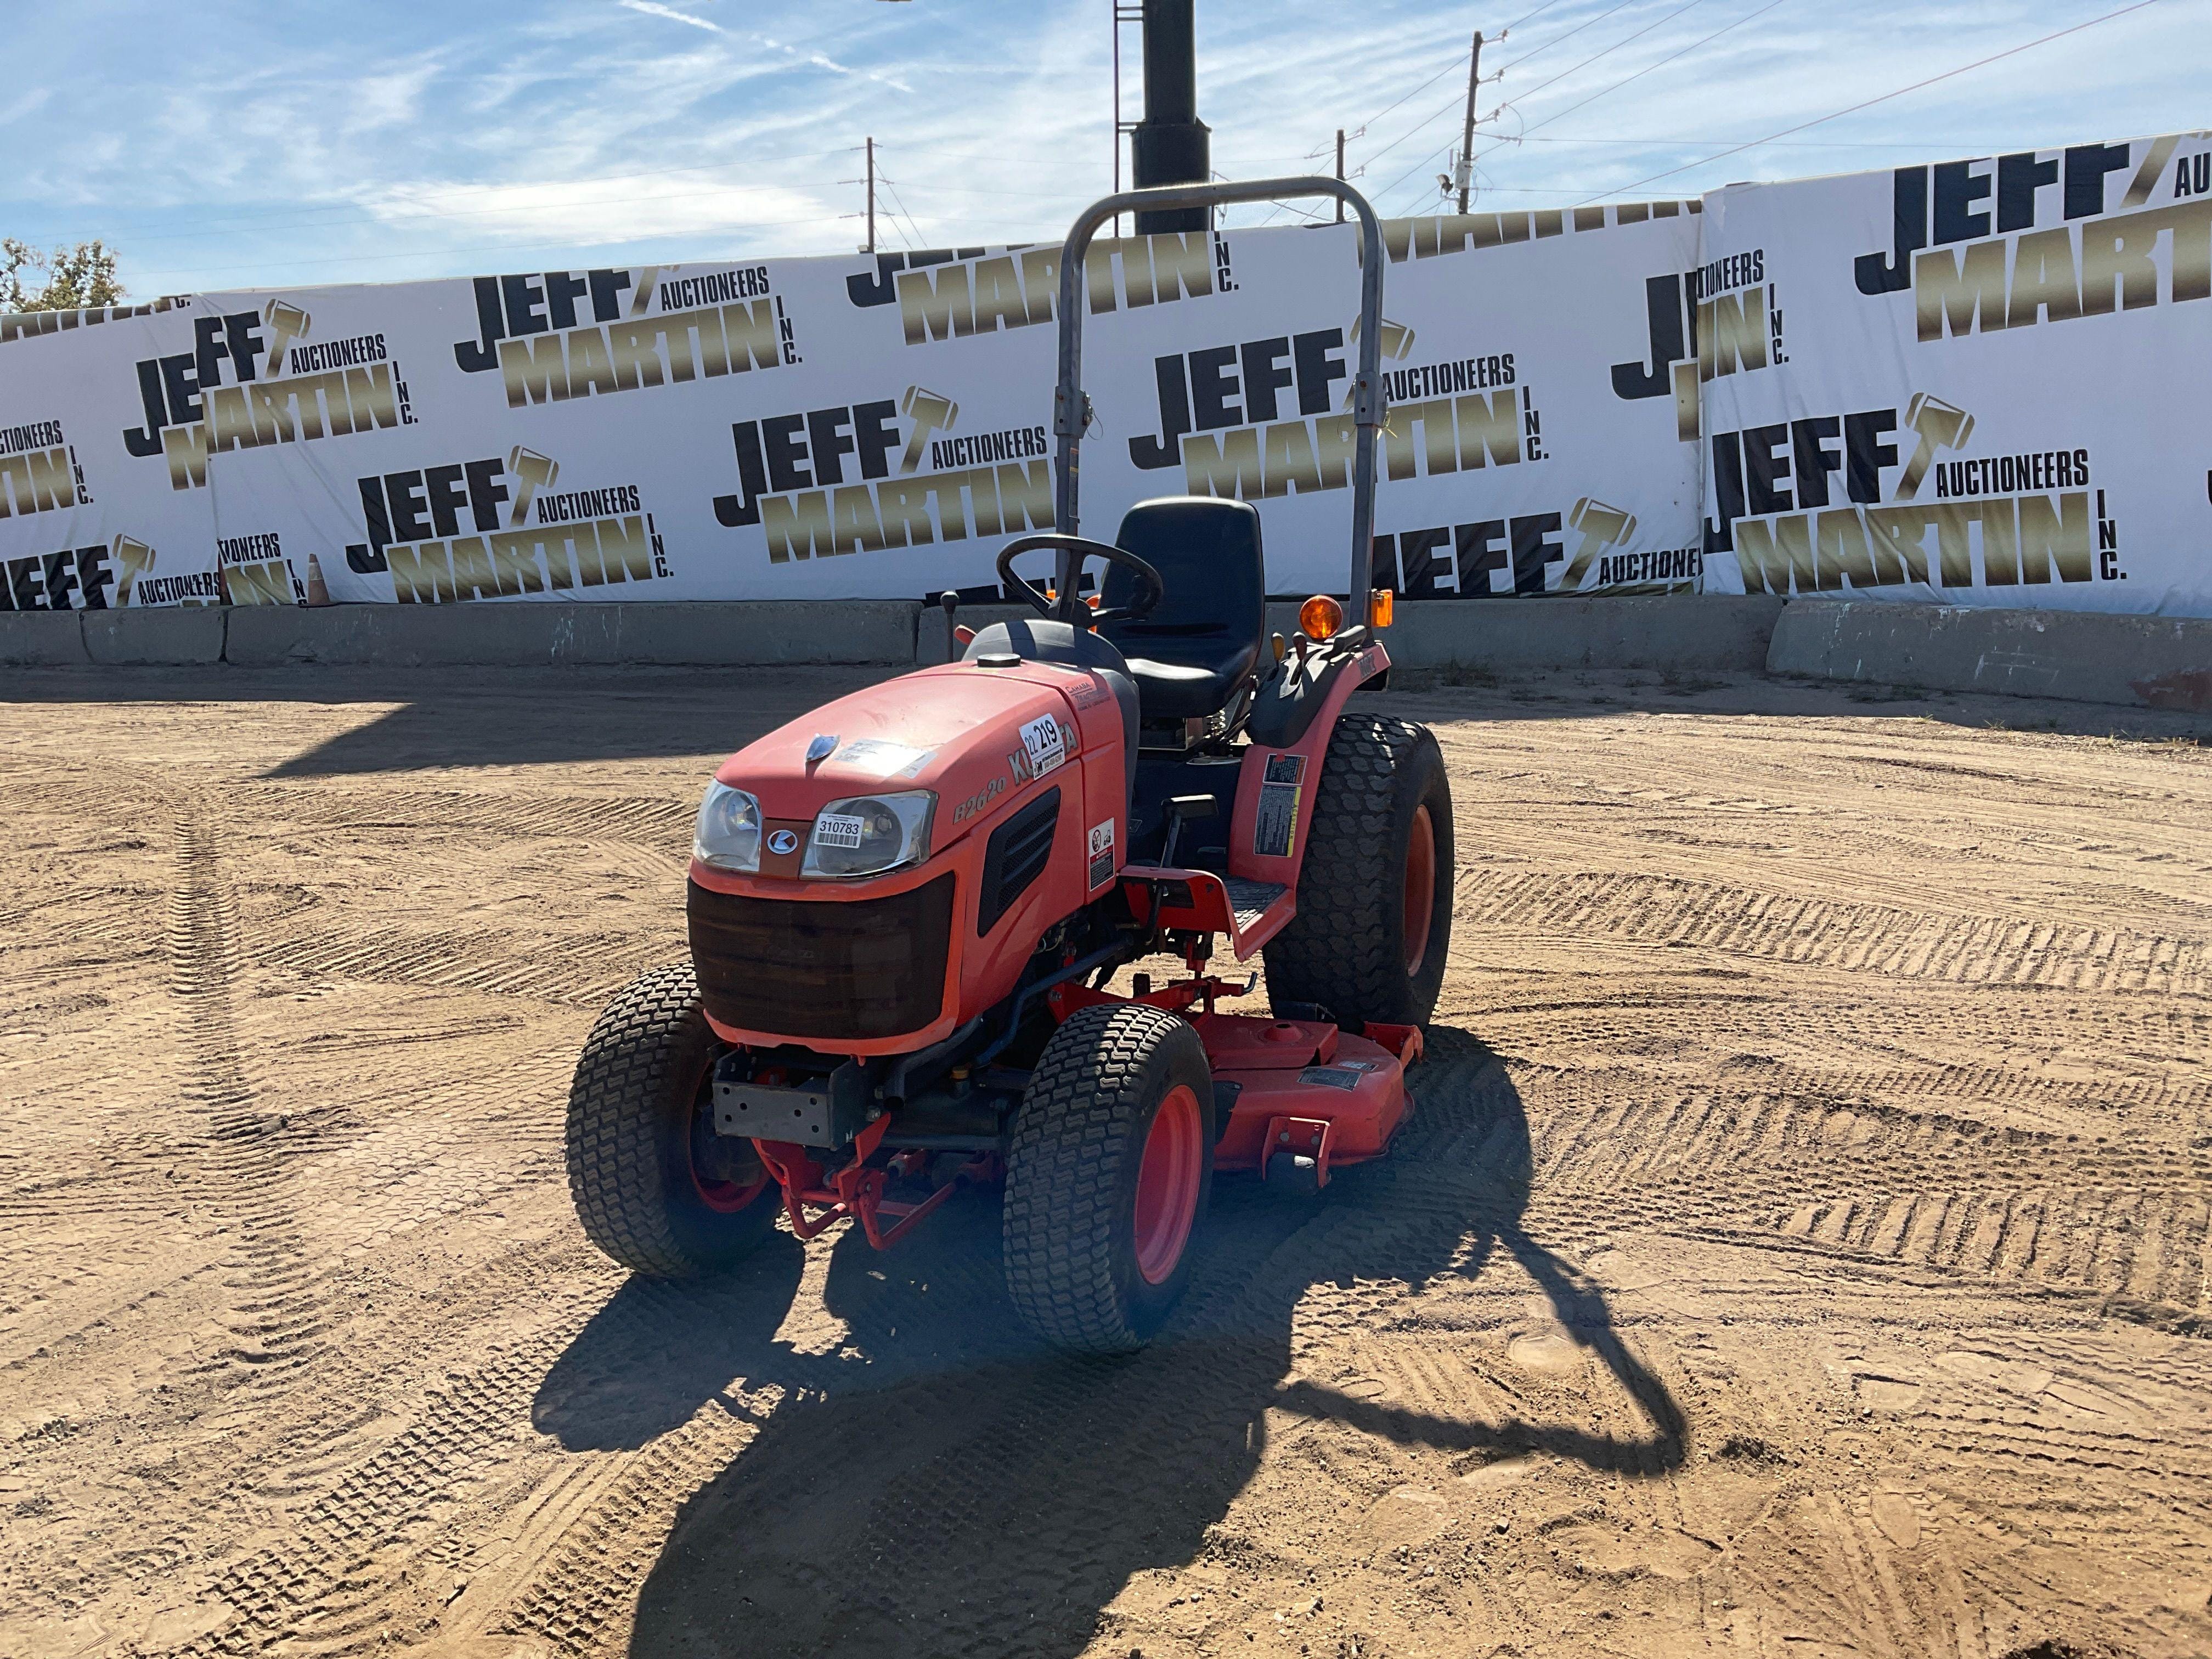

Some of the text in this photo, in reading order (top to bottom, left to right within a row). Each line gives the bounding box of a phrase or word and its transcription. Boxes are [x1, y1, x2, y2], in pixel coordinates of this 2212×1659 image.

[1854, 143, 2130, 296] JEFF
[454, 268, 631, 373] JEFF
[661, 266, 769, 311] AUCTIONEERS
[776, 295, 803, 365] INC.
[897, 231, 1212, 346] MARTIN
[1769, 283, 1789, 365] INC.
[123, 311, 264, 457] JEFF
[291, 334, 386, 374] AUCTIONEERS
[393, 360, 418, 425] INC.
[499, 298, 780, 409] MARTIN
[1129, 328, 1515, 470] JEFF AUCTIONEERS
[713, 399, 1047, 528] JEFF AUCTIONEERS
[1183, 389, 1520, 501] MARTIN
[1522, 385, 1549, 461] INC.
[69, 445, 94, 504] INC.
[345, 458, 641, 574] JEFF AUCTIONEERS
[761, 459, 1055, 565] MARTIN
[1703, 408, 2089, 554] JEFF AUCTIONEERS
[286, 559, 308, 606] IN
[387, 515, 653, 604] MARTIN
[647, 513, 674, 578] INC.
[1736, 492, 2092, 594] MARTIN
[2097, 489, 2127, 580] INC.
[1024, 735, 1039, 755] 22
[1033, 719, 1057, 749] 219
[820, 821, 859, 834] 310783
[953, 776, 1007, 825] B2620
